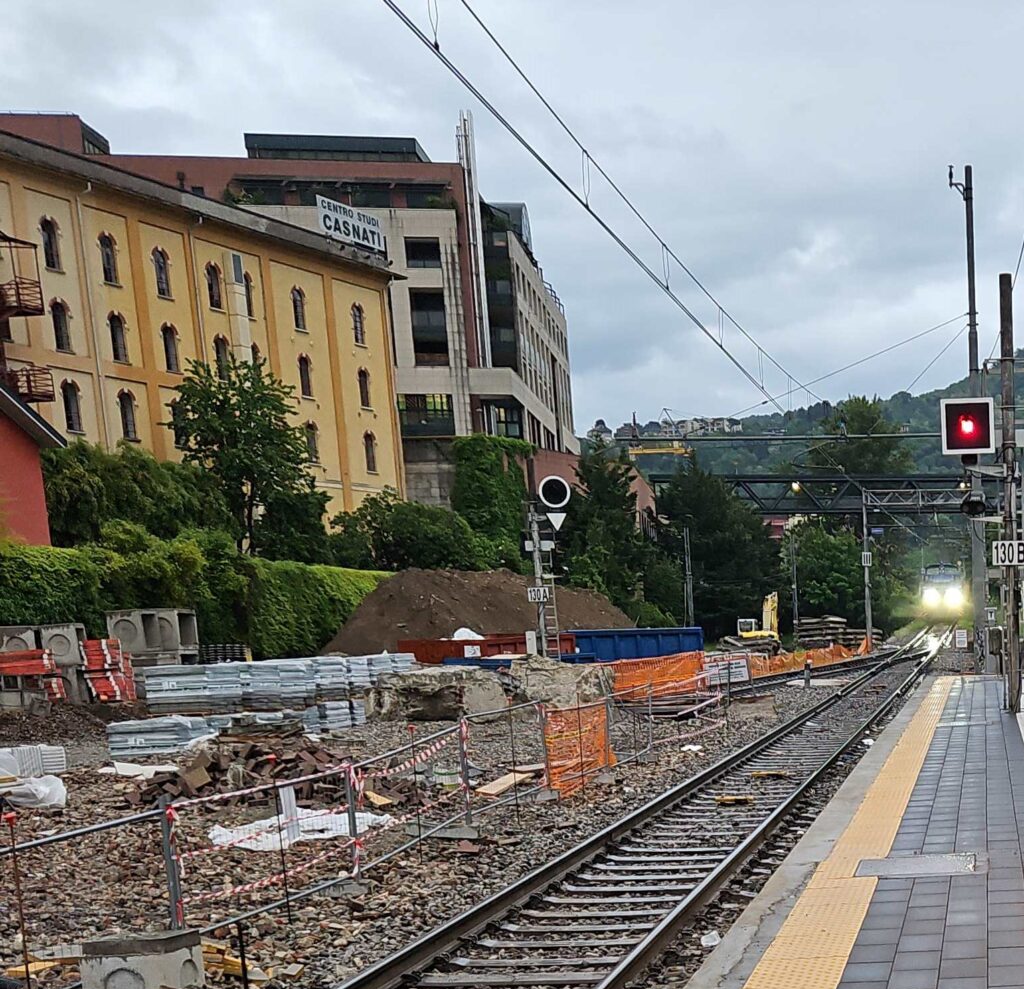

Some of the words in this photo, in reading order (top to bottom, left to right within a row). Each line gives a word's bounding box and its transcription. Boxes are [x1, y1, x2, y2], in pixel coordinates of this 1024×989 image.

[320, 199, 354, 219] CENTRO
[356, 211, 380, 228] STUDI
[322, 213, 382, 248] CASNATI
[994, 542, 1015, 564] 130
[529, 588, 541, 601] 130
[542, 588, 549, 602] A
